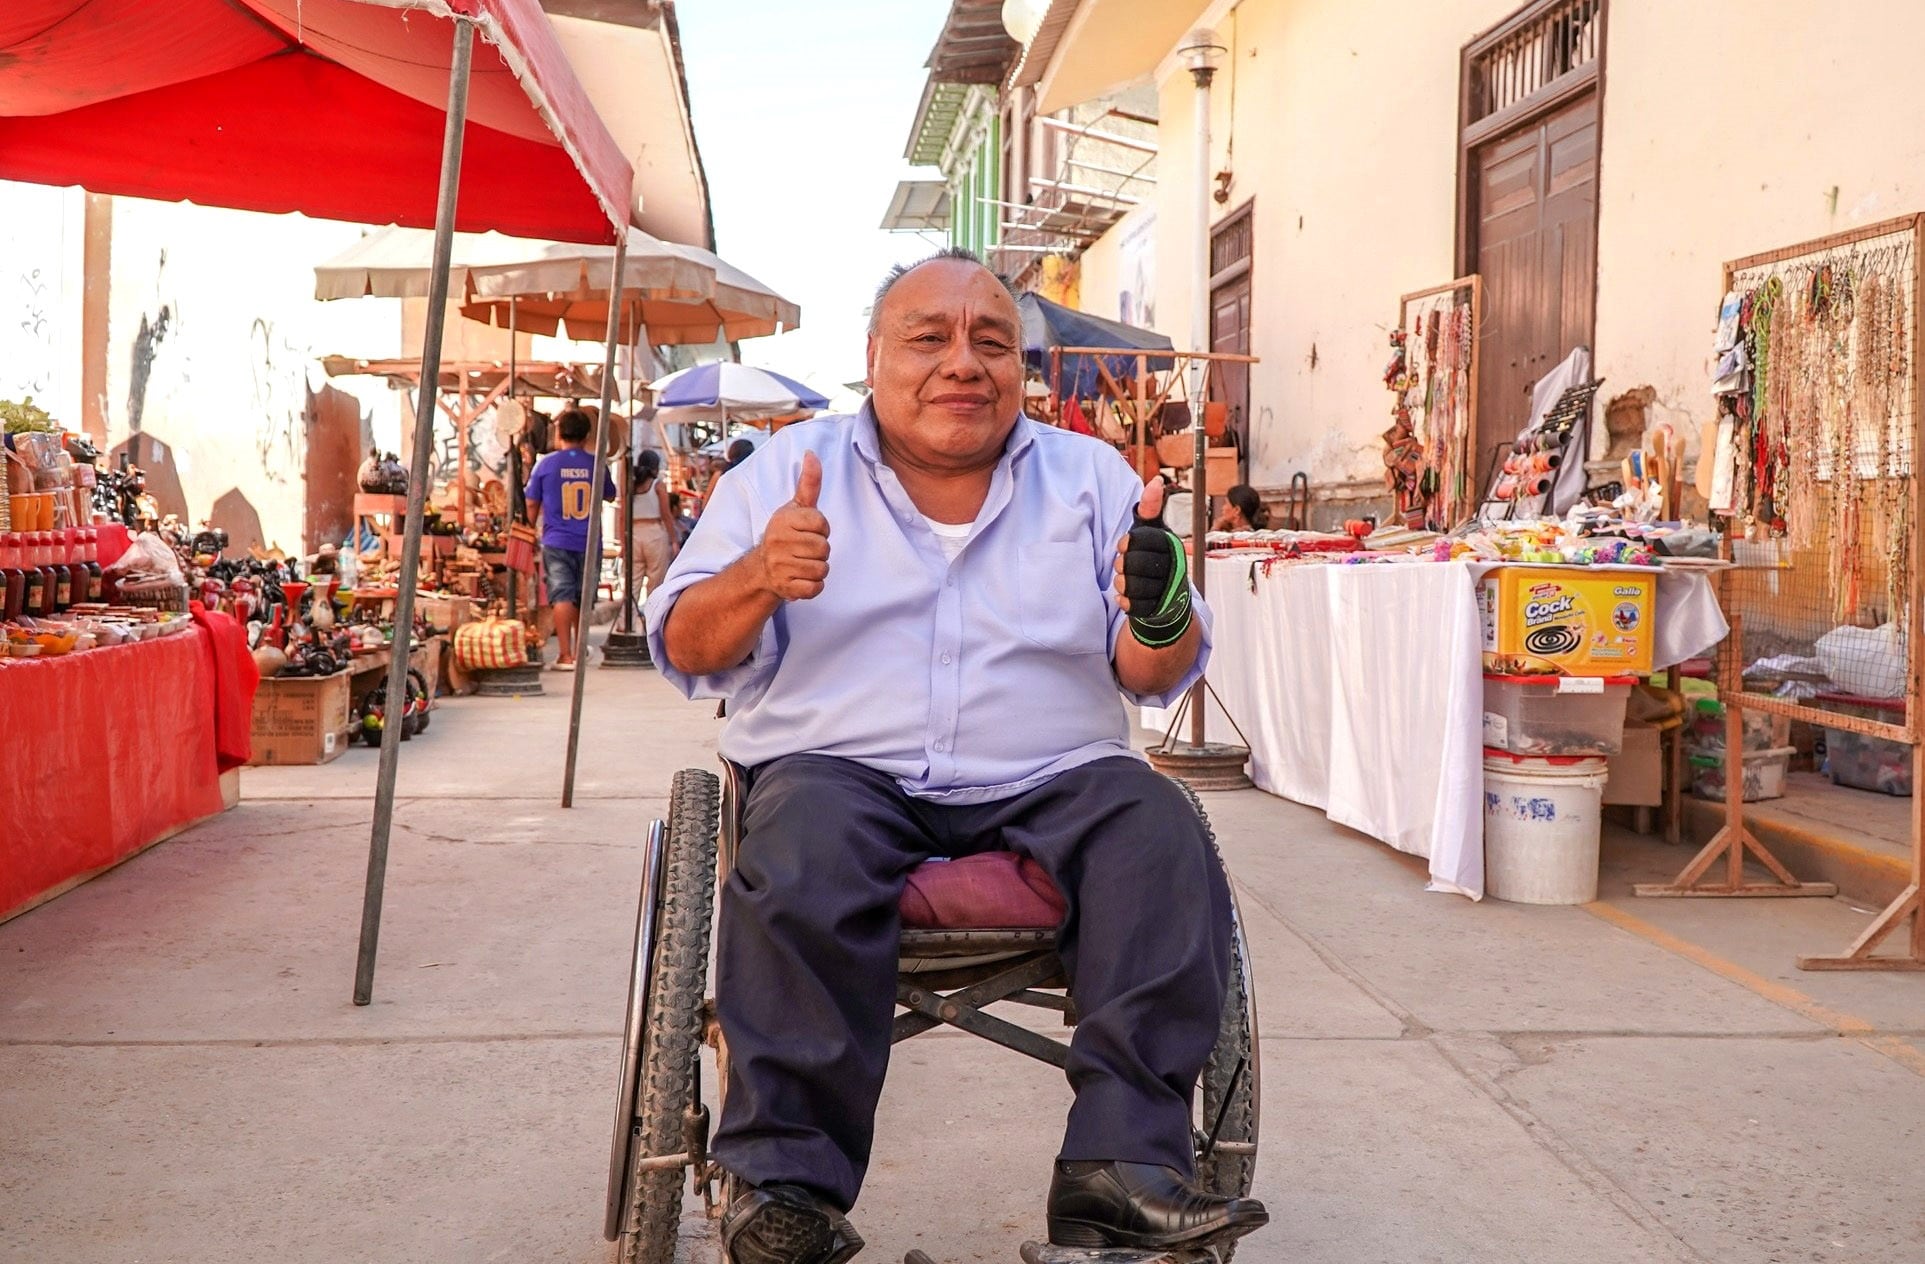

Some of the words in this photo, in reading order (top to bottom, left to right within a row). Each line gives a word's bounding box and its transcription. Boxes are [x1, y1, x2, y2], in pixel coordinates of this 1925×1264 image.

[560, 468, 589, 479] MESSI
[561, 481, 591, 520] 10
[1614, 587, 1641, 596] Gallo
[1525, 596, 1574, 618] Cock
[1526, 614, 1553, 627] Brand
